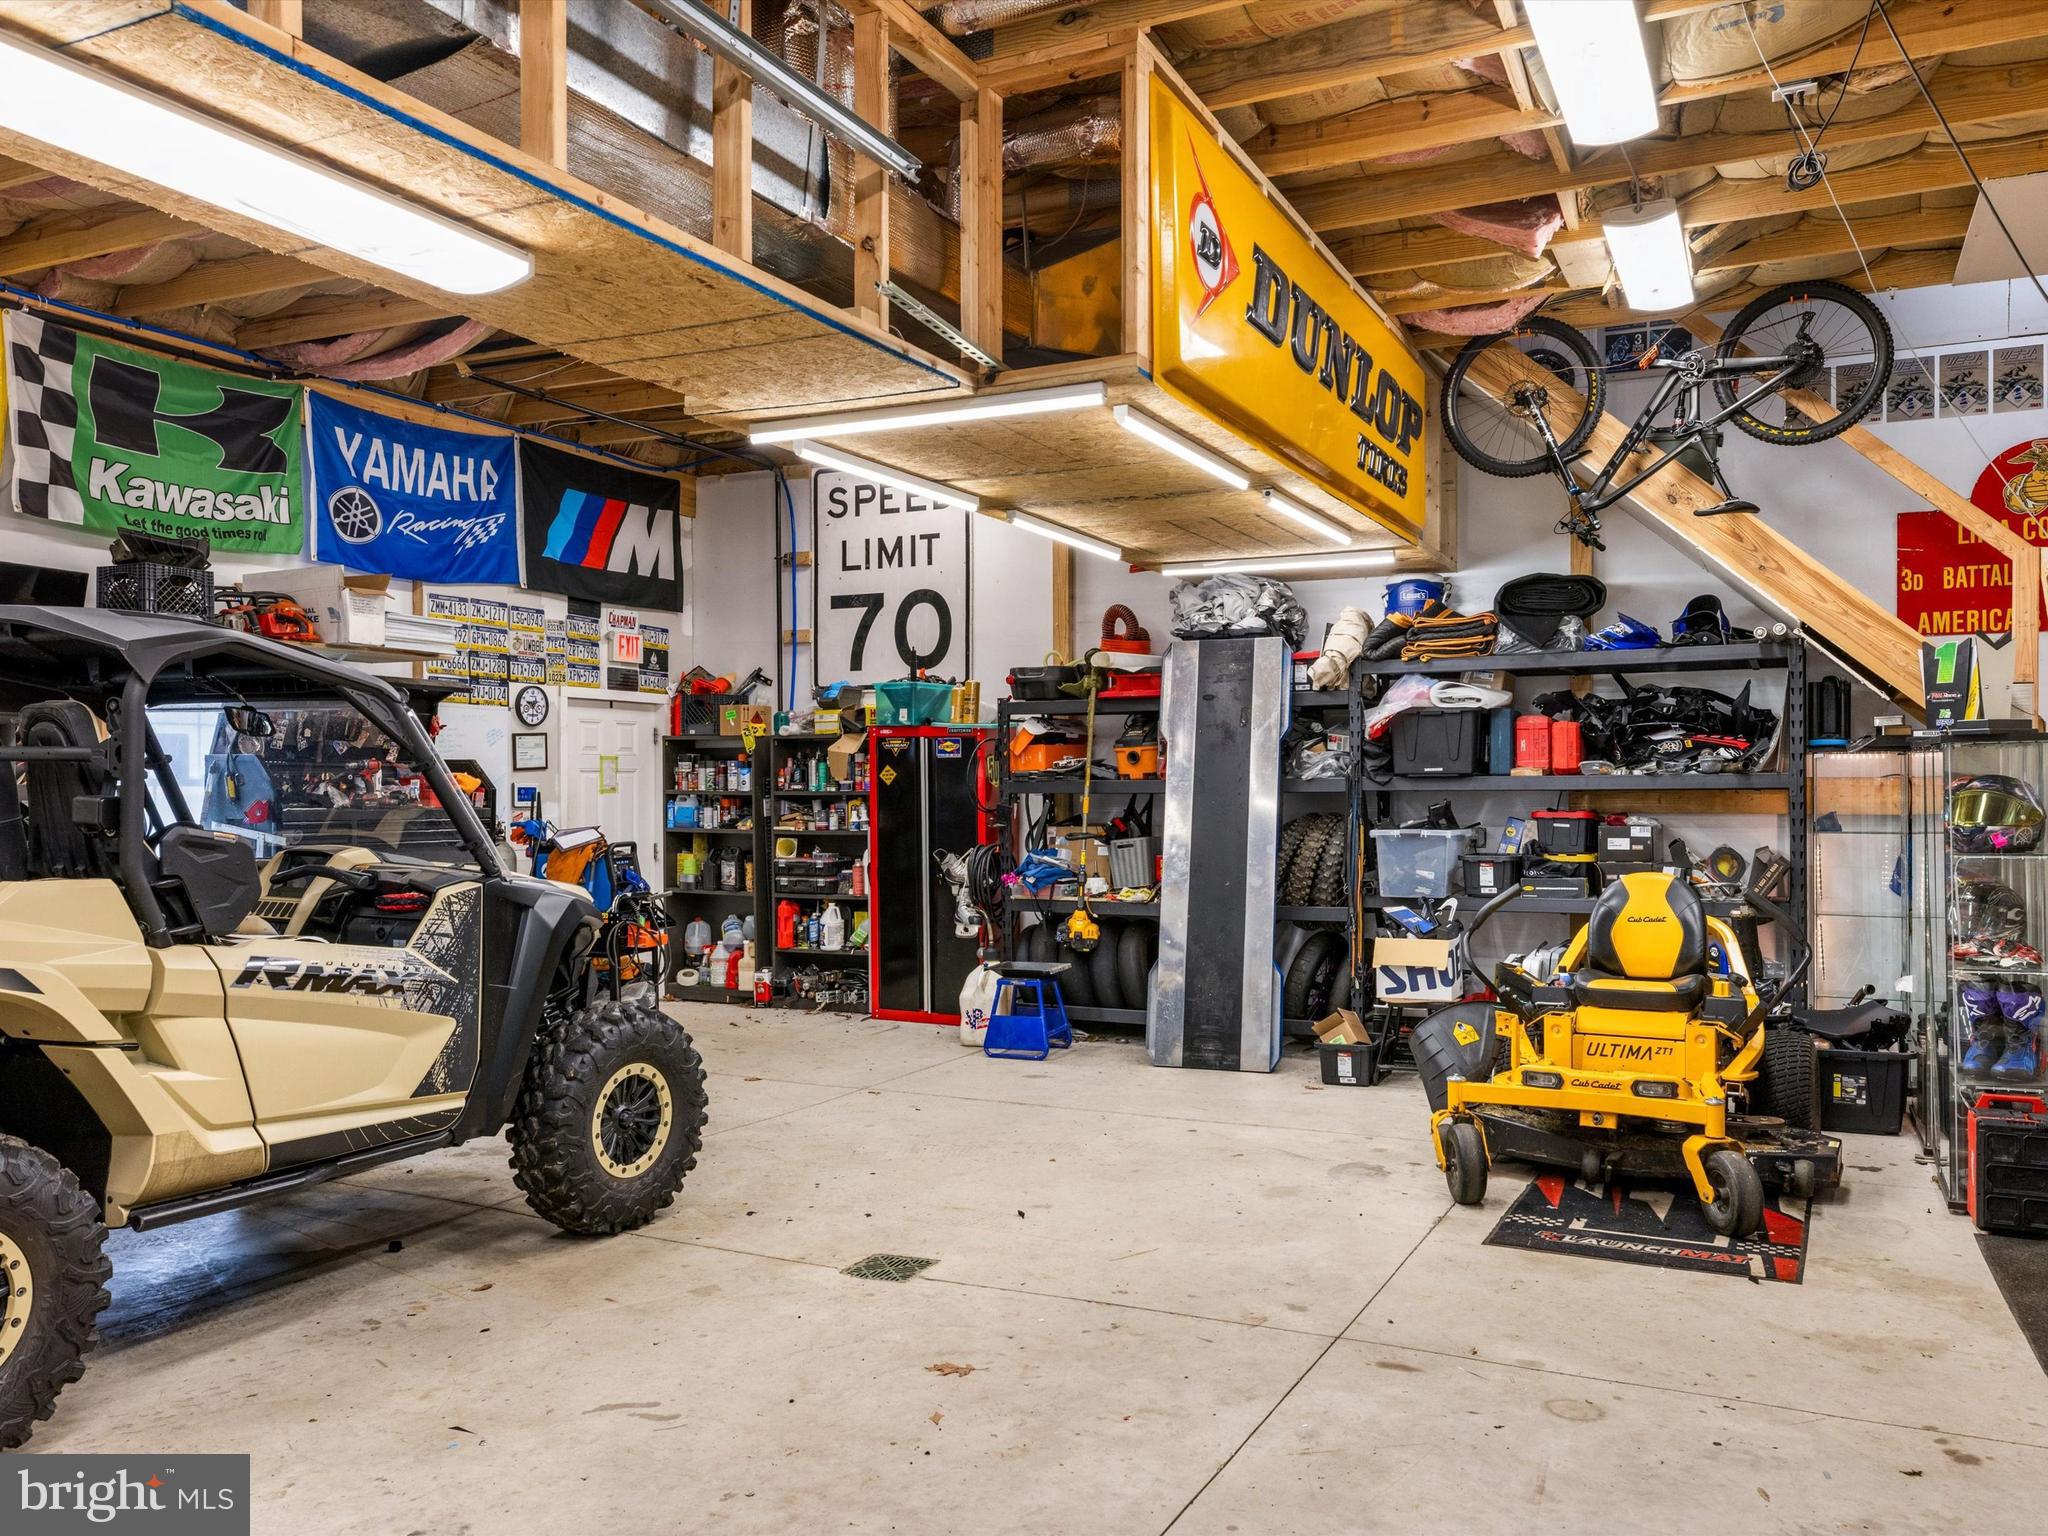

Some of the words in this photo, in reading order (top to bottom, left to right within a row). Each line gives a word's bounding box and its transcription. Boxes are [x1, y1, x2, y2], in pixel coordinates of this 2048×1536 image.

[1245, 242, 1424, 456] DUNLOP
[334, 426, 499, 502] YAMAHA
[1357, 433, 1408, 499] TIRES
[88, 456, 292, 525] Kawasaki
[827, 483, 952, 519] SPEE
[124, 513, 148, 532] Let
[151, 518, 174, 535] the
[175, 525, 210, 540] good
[212, 527, 251, 541] times
[386, 510, 482, 545] Racing
[841, 532, 941, 572] LIMIT
[608, 611, 637, 628] CHAPMAN
[830, 588, 953, 672] 70
[618, 634, 640, 658] EXIT
[1935, 641, 1959, 684] 1
[1627, 915, 1643, 923] Cub
[1643, 915, 1667, 923] Cadet
[1586, 1041, 1652, 1061] ULTIMA
[1655, 1047, 1674, 1057] ZT1
[1571, 1078, 1591, 1088] Cub
[1591, 1080, 1622, 1091] Cadet
